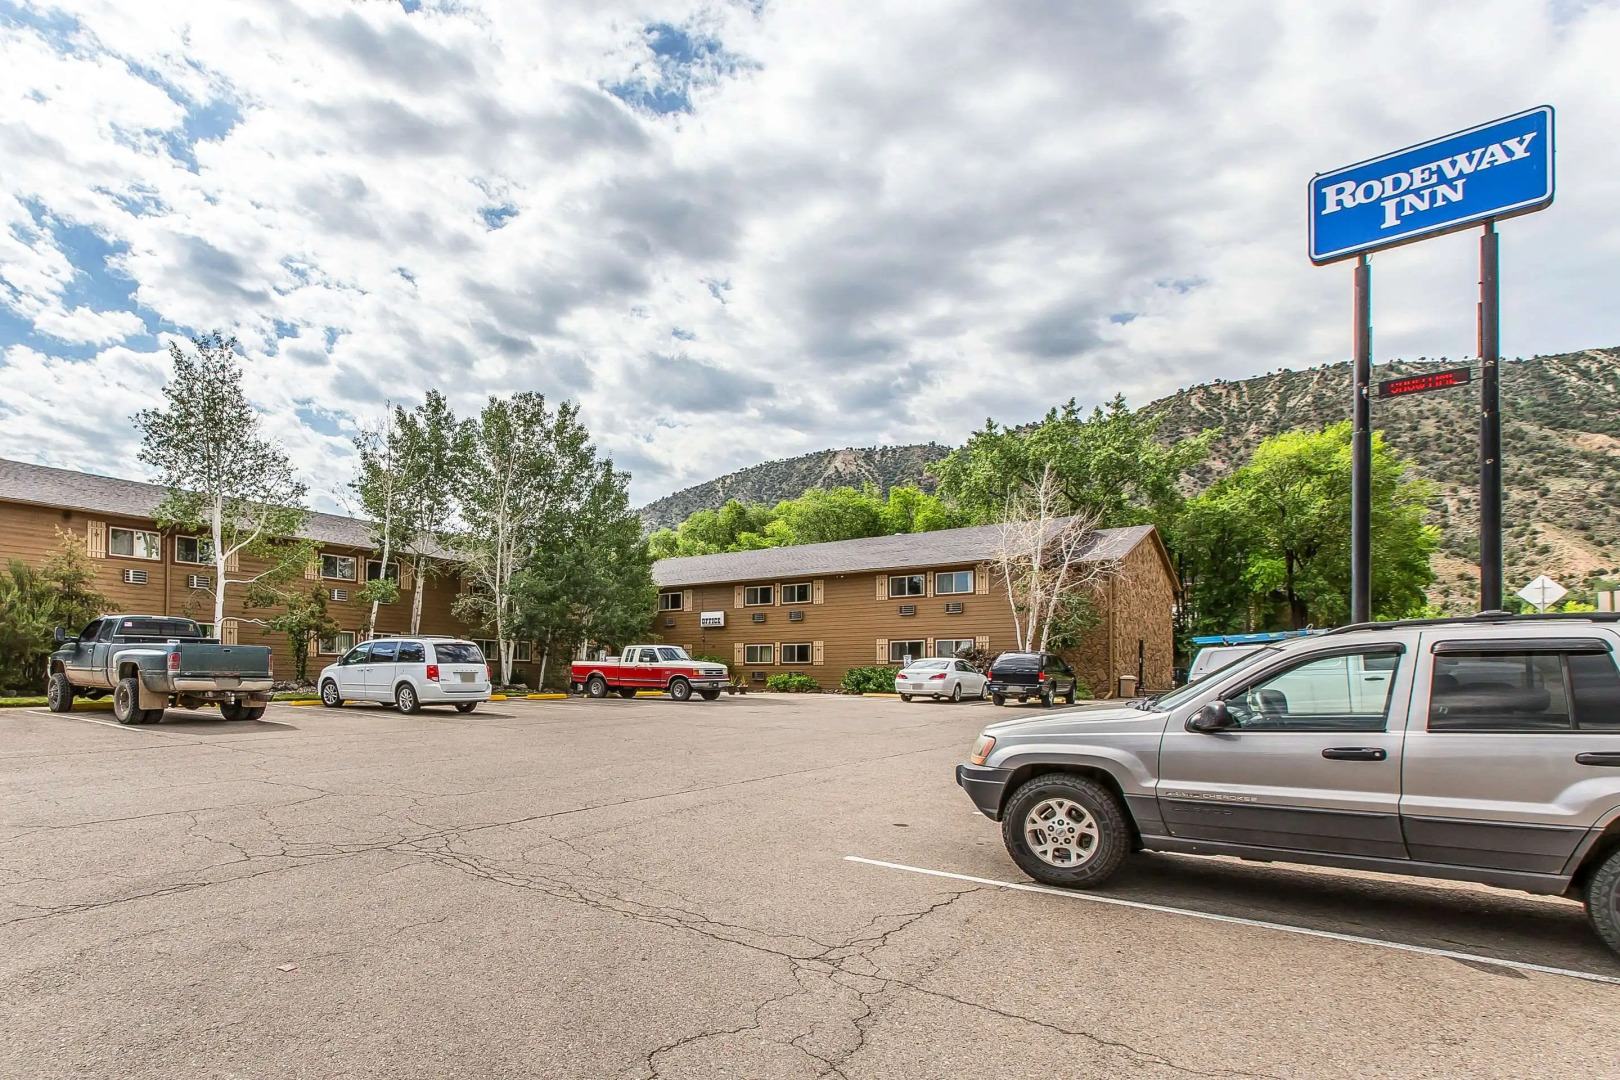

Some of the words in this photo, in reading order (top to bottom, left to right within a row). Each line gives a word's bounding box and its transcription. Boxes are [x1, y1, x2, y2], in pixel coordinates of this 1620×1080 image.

[1321, 131, 1538, 216] RODEWAY
[1380, 178, 1467, 230] INN
[702, 617, 721, 625] OFFICE
